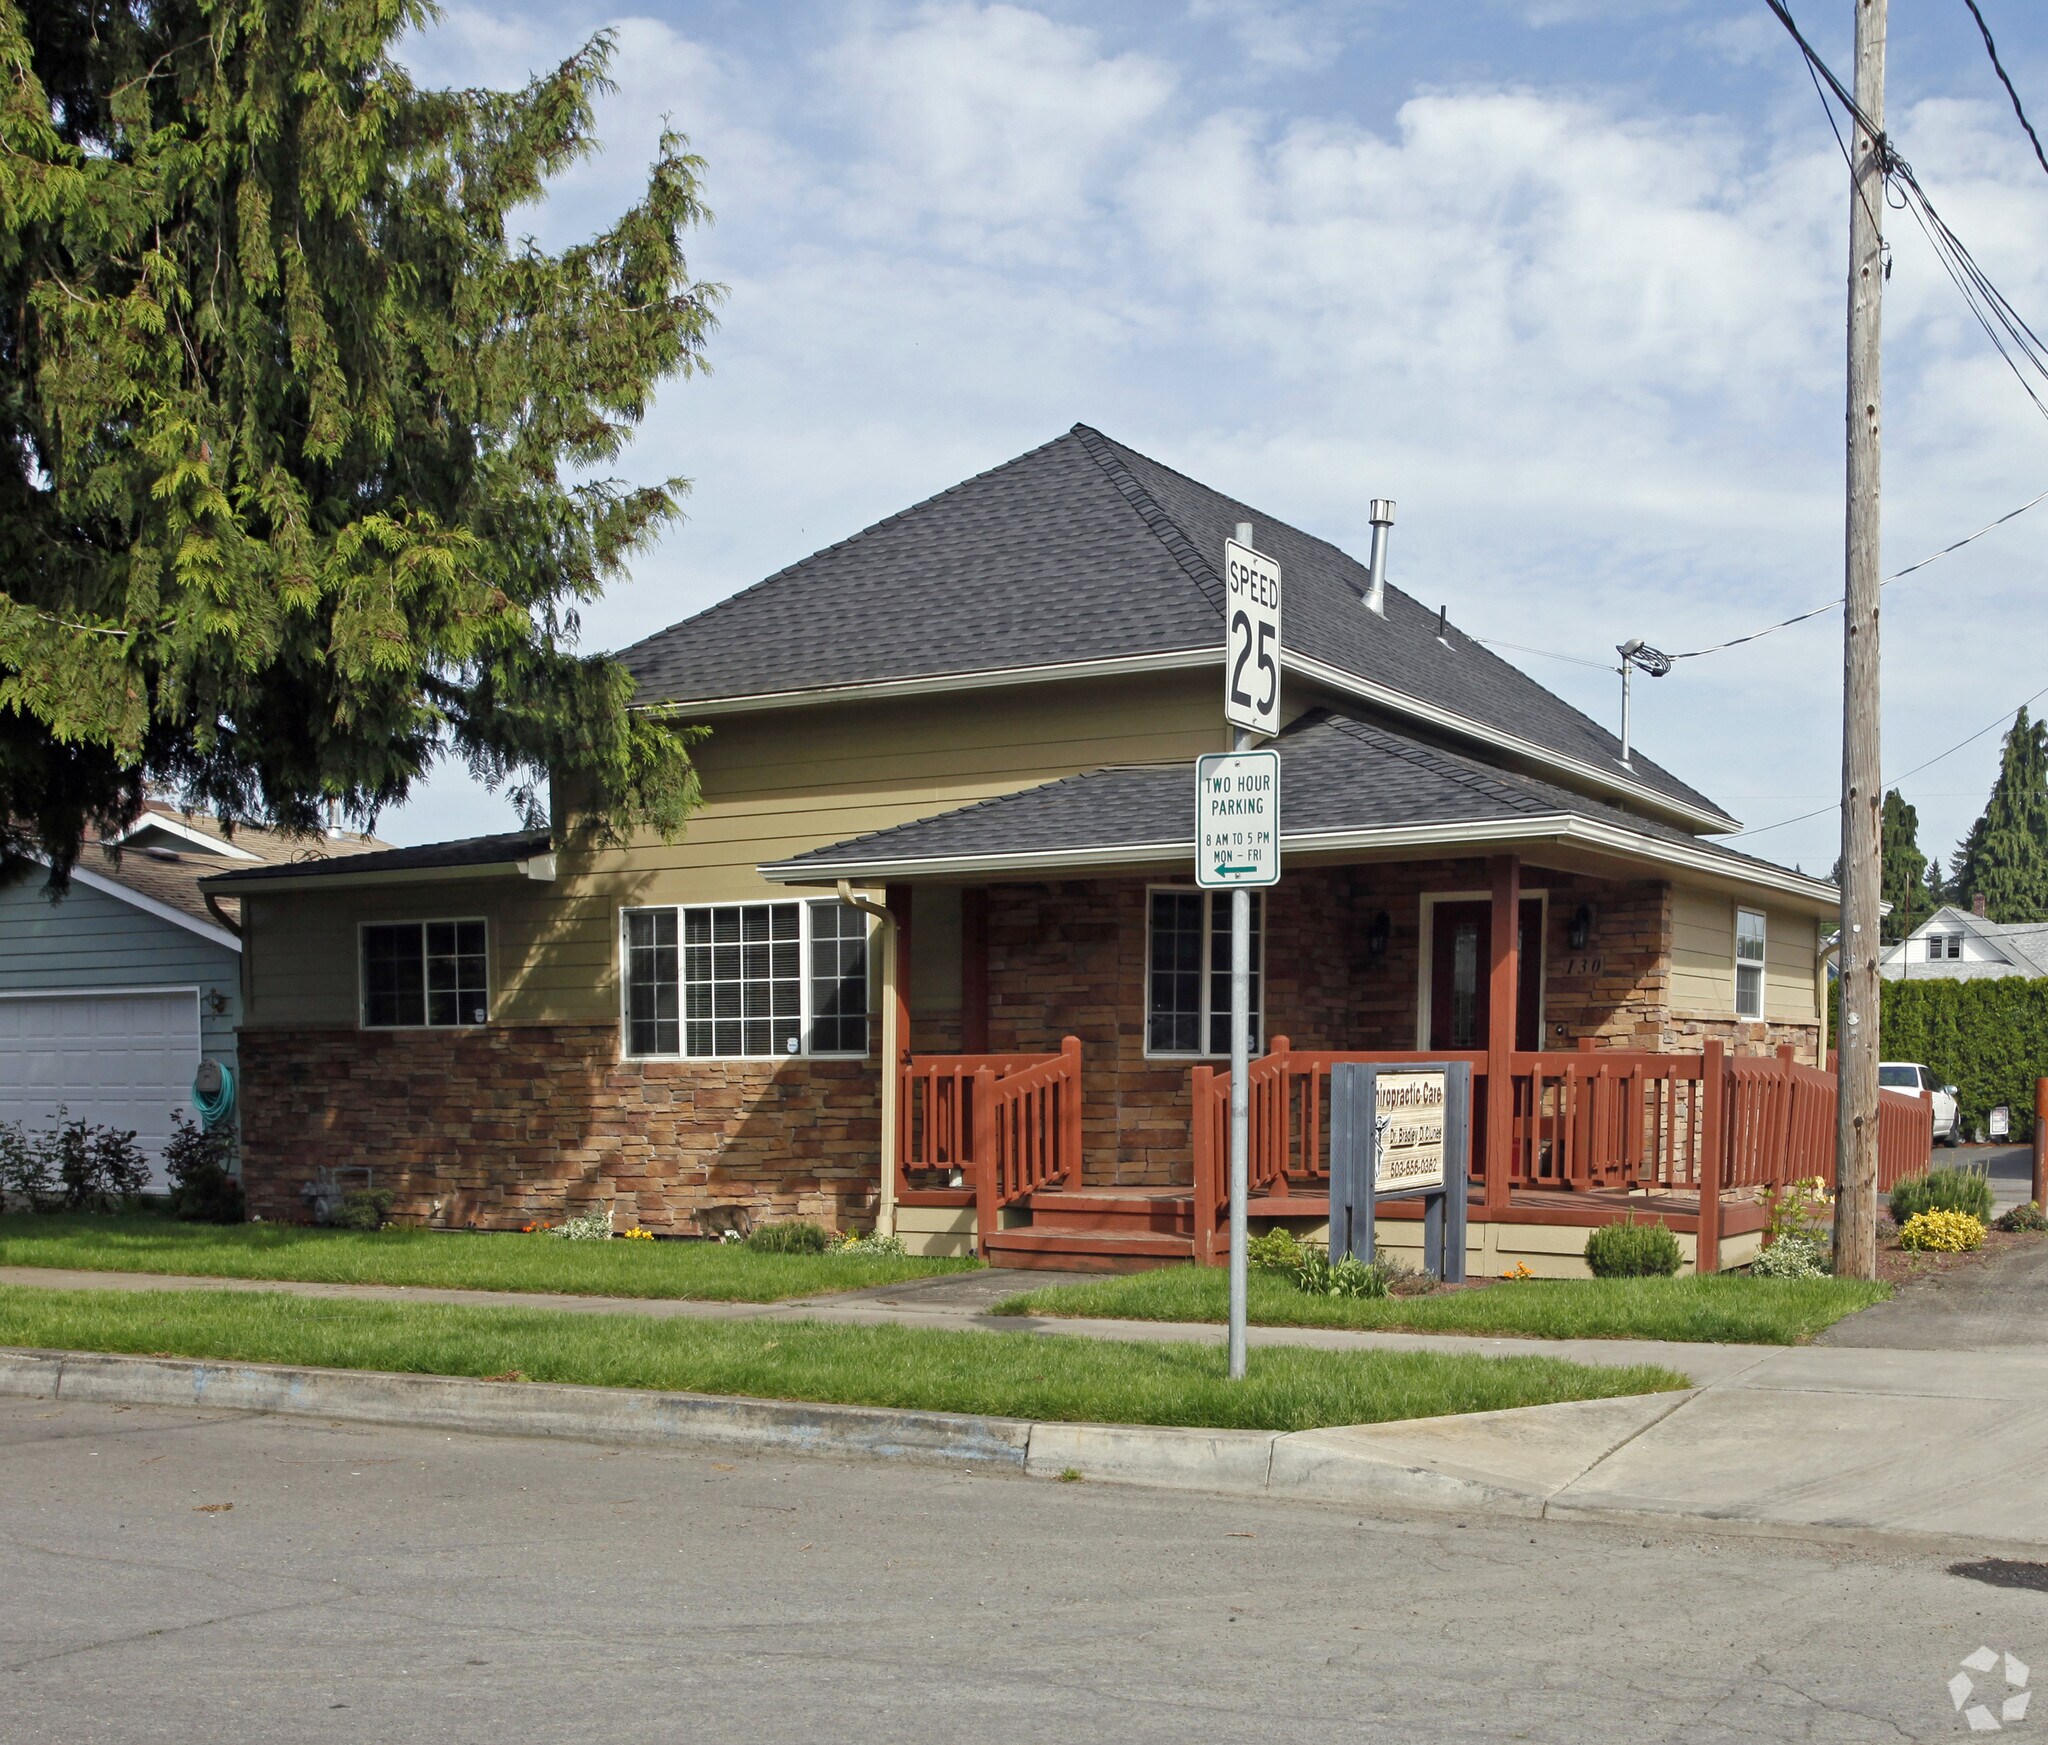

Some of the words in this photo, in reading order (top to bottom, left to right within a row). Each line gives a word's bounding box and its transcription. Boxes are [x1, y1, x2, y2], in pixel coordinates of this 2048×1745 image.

[1230, 560, 1278, 610] SPEED
[1231, 609, 1277, 716] 25
[1206, 777, 1231, 794] TWO
[1238, 775, 1270, 792] HOUR
[1212, 798, 1264, 816] PARKING
[1206, 834, 1212, 847] 8
[1215, 833, 1229, 846] AM
[1233, 832, 1243, 845] TO
[1247, 832, 1253, 845] 5
[1257, 831, 1270, 844] PM
[1214, 850, 1233, 863] MON
[1248, 849, 1262, 862] FRI
[1567, 959, 1601, 975] 130
[1376, 1082, 1421, 1111] iropractic
[1423, 1081, 1442, 1104] Care
